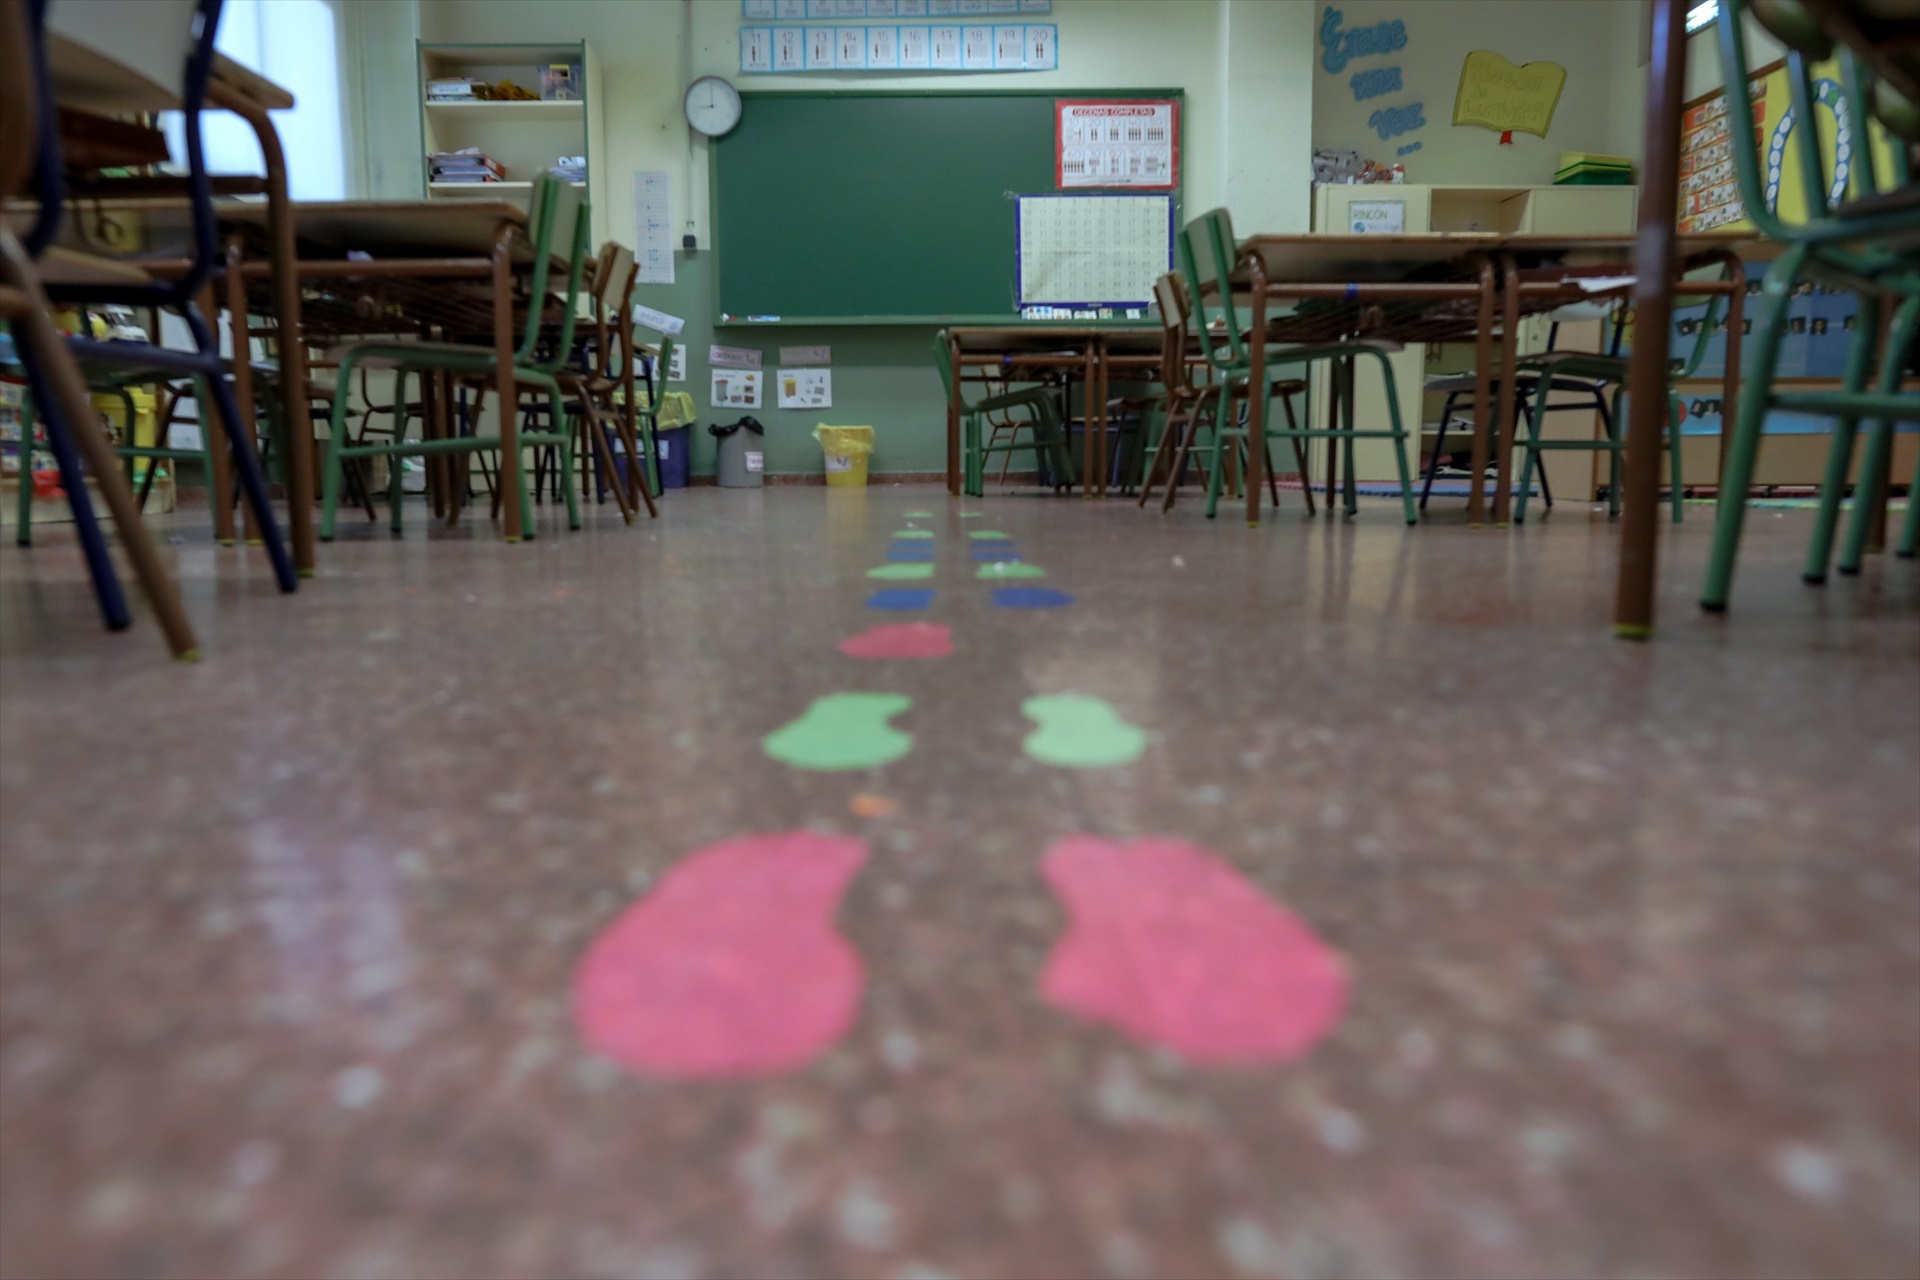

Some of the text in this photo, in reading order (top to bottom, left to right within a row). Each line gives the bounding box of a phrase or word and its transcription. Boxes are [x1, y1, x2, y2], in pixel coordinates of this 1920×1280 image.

[783, 31, 794, 43] 12
[816, 31, 827, 43] 13
[909, 30, 921, 41] 16
[941, 29, 952, 41] 17
[971, 30, 983, 41] 18
[1004, 29, 1015, 40] 19
[1033, 29, 1048, 41] 20
[1349, 66, 1403, 102] una
[1074, 107, 1153, 116] DECENAS COMPLETAS
[1367, 102, 1427, 141] vez
[1353, 206, 1388, 220] RINCÓN
